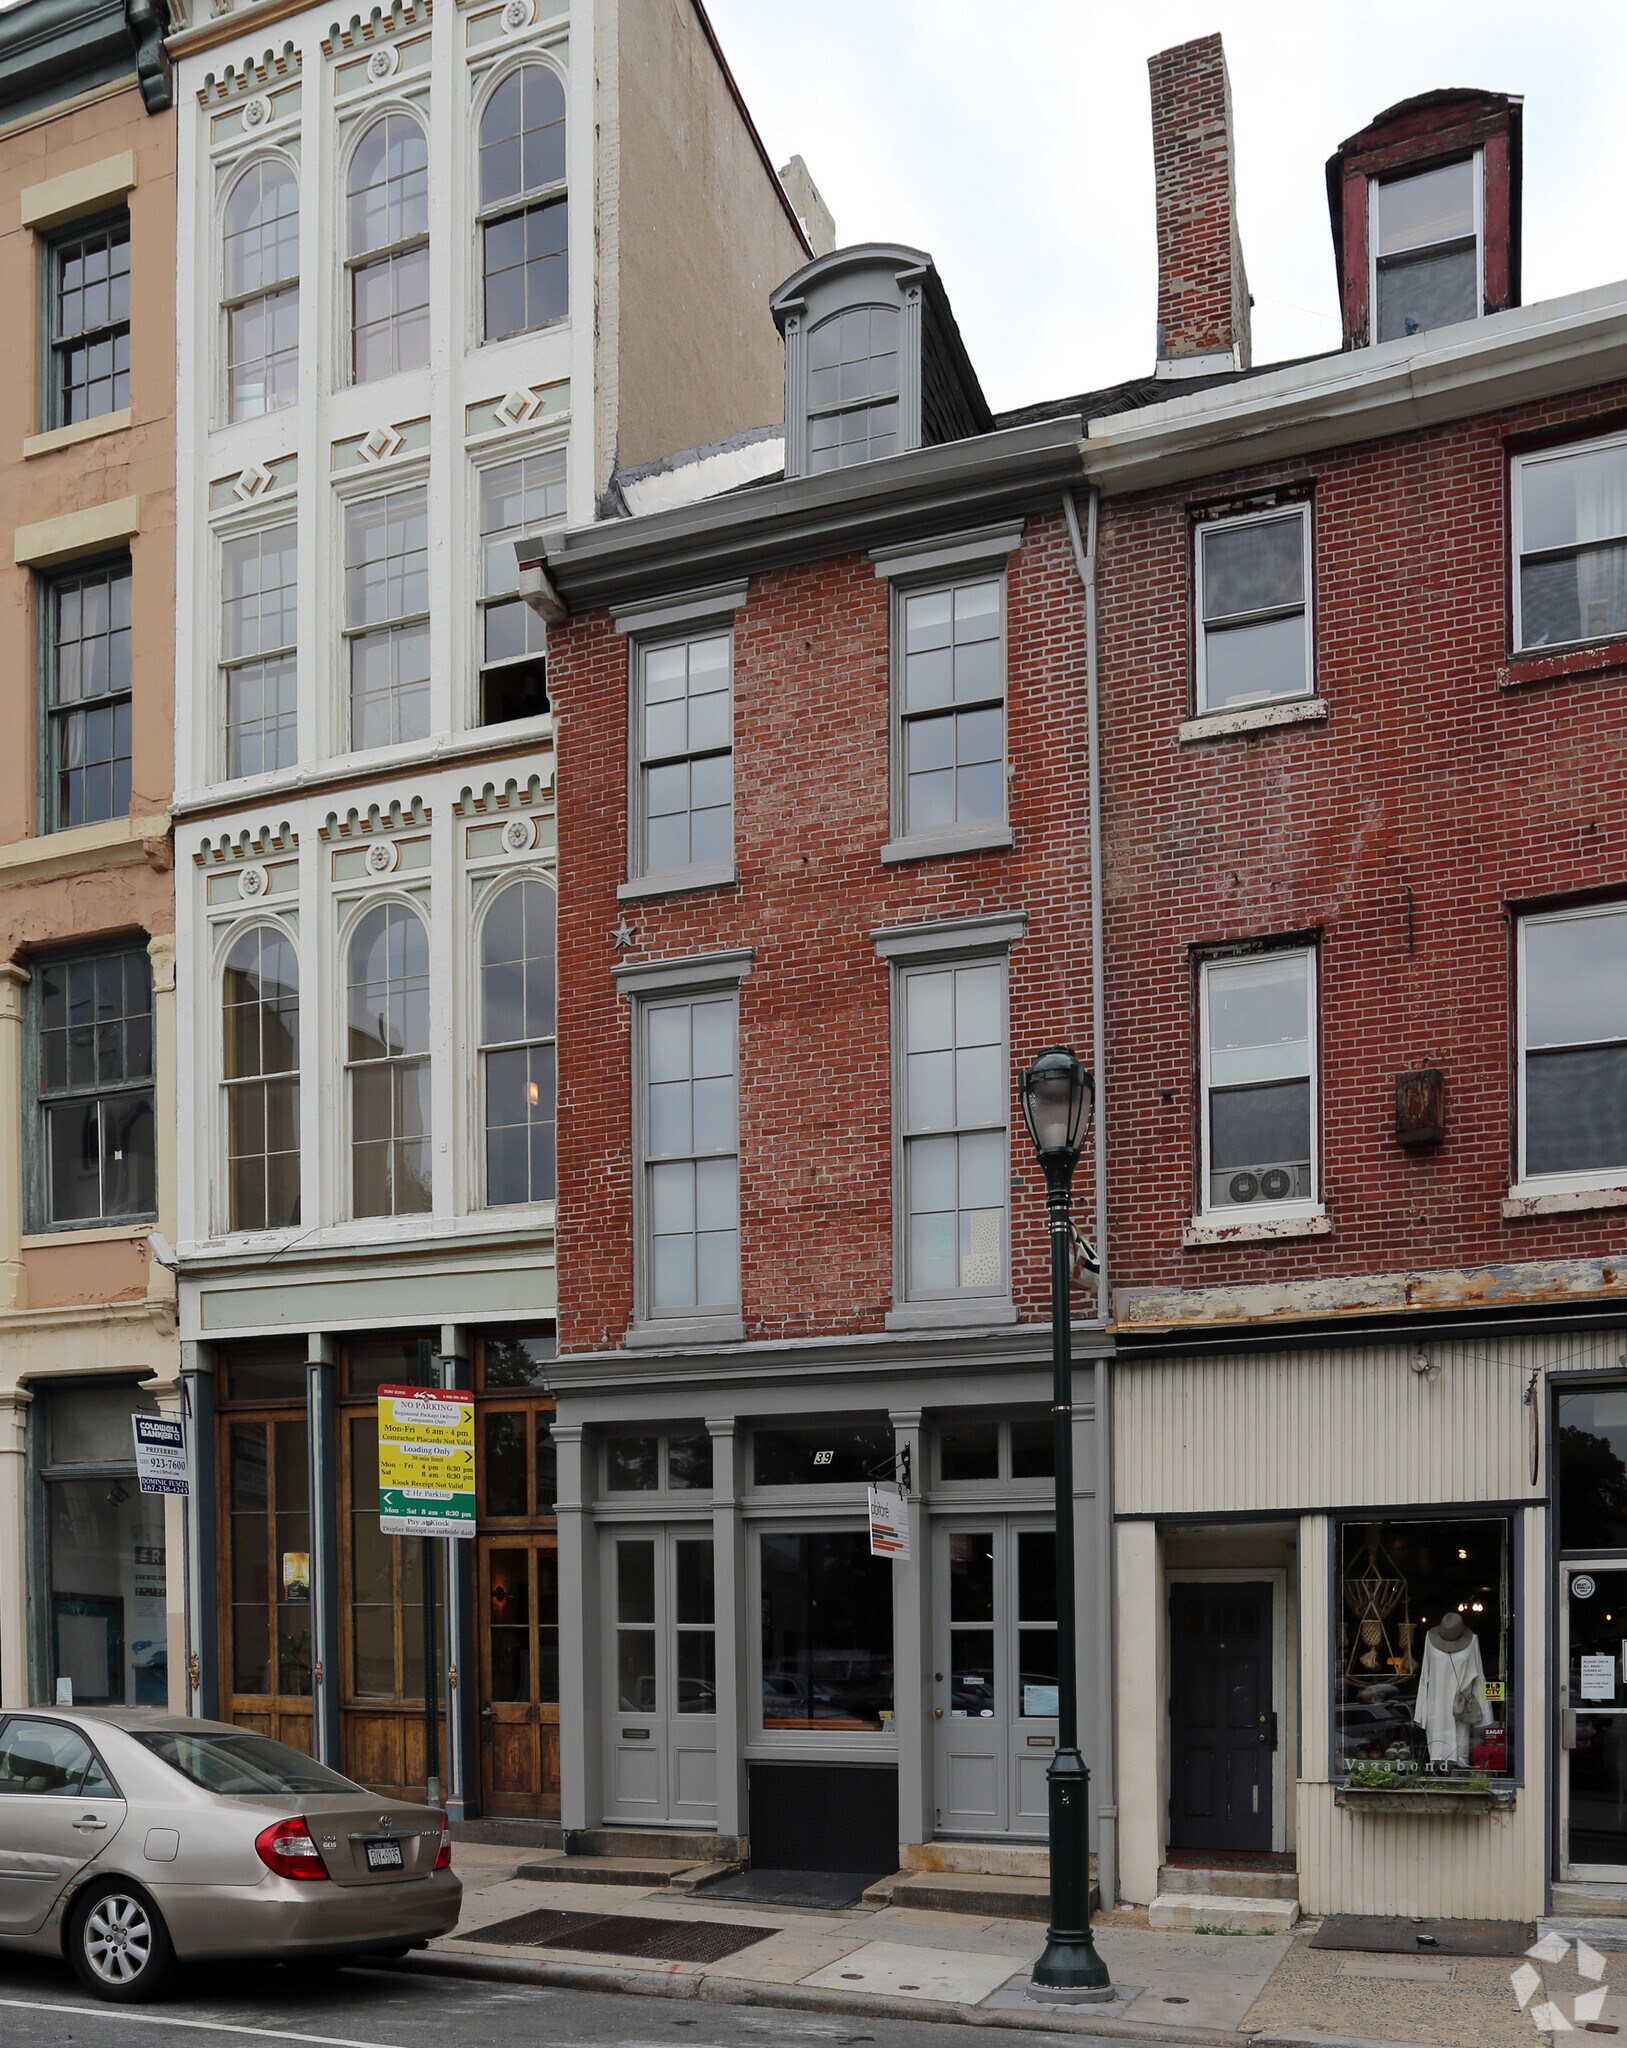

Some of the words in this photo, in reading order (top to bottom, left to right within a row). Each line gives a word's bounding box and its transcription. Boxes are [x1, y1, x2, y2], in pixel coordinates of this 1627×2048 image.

[416, 1402, 453, 1411] PARKING
[420, 1412, 439, 1420] Package
[140, 1422, 180, 1433] COLDWELL
[384, 1425, 415, 1433] Mon-Fri
[140, 1430, 173, 1440] BANKER
[382, 1434, 415, 1442] Contractor
[416, 1436, 442, 1444] Placards
[457, 1438, 472, 1446] Valid
[146, 1446, 178, 1455] PREFERRED
[404, 1446, 432, 1455] Loading
[434, 1447, 451, 1456] Only
[816, 1452, 832, 1463] 39
[150, 1458, 185, 1470] 923-7600
[142, 1478, 167, 1486] DOMINIC
[411, 1481, 434, 1489] Receipt
[424, 1491, 450, 1499] Parking
[431, 1519, 449, 1527] Kiosk
[1344, 1758, 1449, 1772] Vagabond
